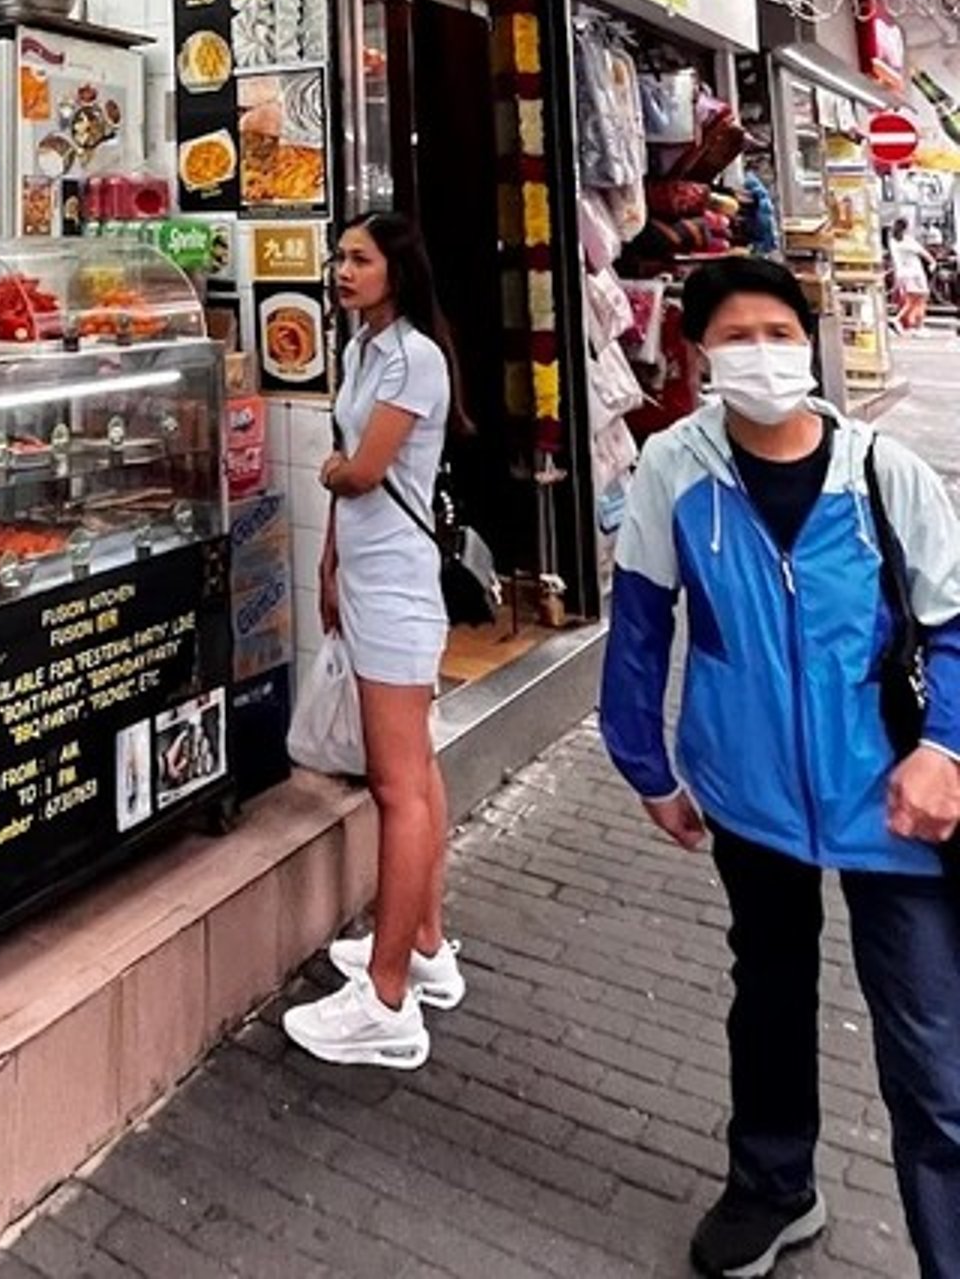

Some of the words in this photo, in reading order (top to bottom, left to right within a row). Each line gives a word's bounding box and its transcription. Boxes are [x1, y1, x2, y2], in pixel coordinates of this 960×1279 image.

[168, 227, 208, 254] Sprite
[41, 600, 87, 628] FUSION
[50, 618, 94, 647] FUSION
[49, 658, 75, 681] FOR
[1, 759, 39, 791] FROM
[17, 785, 38, 806] TO
